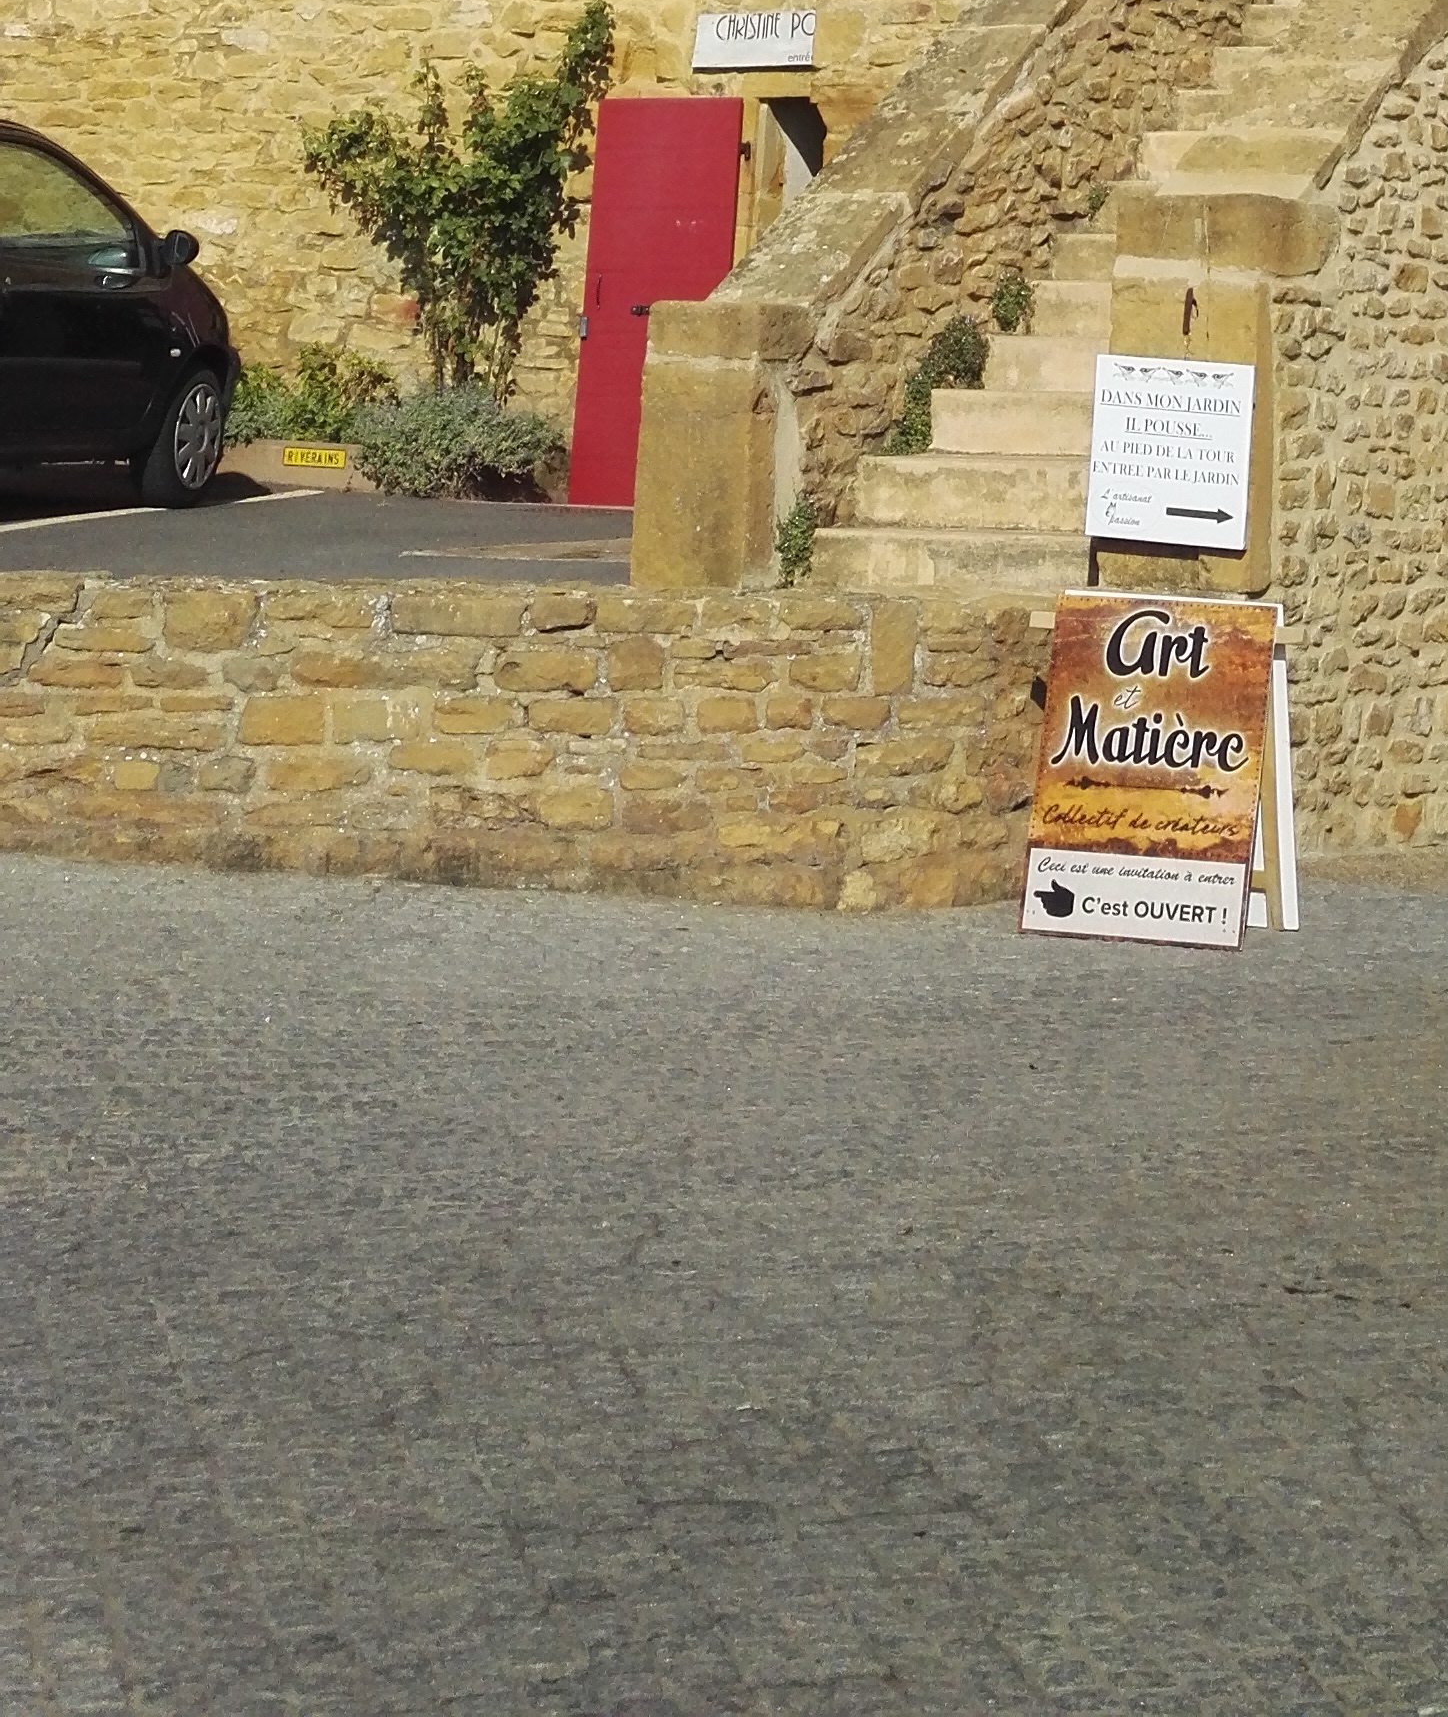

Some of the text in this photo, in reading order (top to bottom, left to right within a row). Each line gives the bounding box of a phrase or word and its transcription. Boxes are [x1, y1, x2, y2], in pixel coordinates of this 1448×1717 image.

[716, 12, 781, 41] CHRISTINE
[1101, 389, 1242, 415] DANS MON JARDIN
[1125, 417, 1142, 432] IL
[288, 450, 340, 465] RIVERAINS
[1100, 440, 1235, 463] AU PIED DE LA TOUR
[1092, 461, 1240, 486] ENTREE PAR LE JARDIN
[1101, 489, 1153, 503] L'artisanat
[1113, 684, 1142, 710] et
[1051, 695, 1249, 773] Matière
[1042, 803, 1240, 836] Collectif de créateurs
[1037, 856, 1236, 885] Ceci est une invitation à entrer
[1081, 896, 1228, 925] C'est OUVERT !
